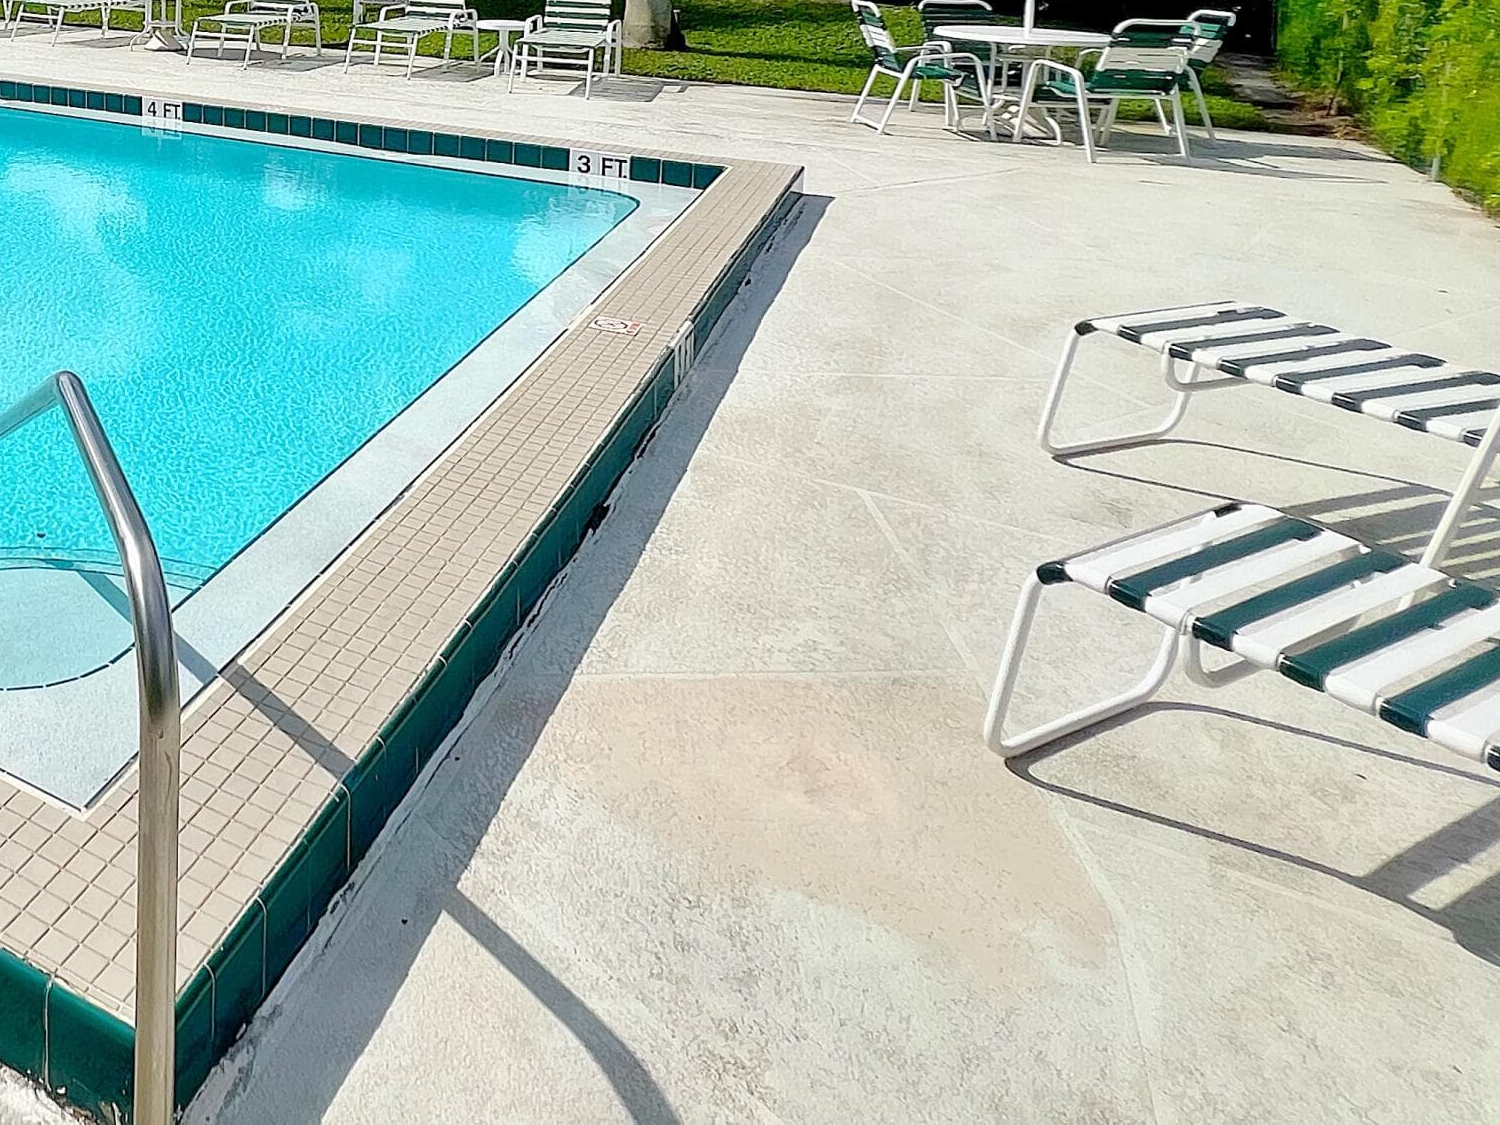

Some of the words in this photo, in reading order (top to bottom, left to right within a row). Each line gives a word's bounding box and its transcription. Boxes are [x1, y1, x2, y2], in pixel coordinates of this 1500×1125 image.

[148, 101, 157, 117] 4
[163, 102, 181, 120] FT.
[577, 155, 591, 174] 3
[601, 157, 628, 178] FT.
